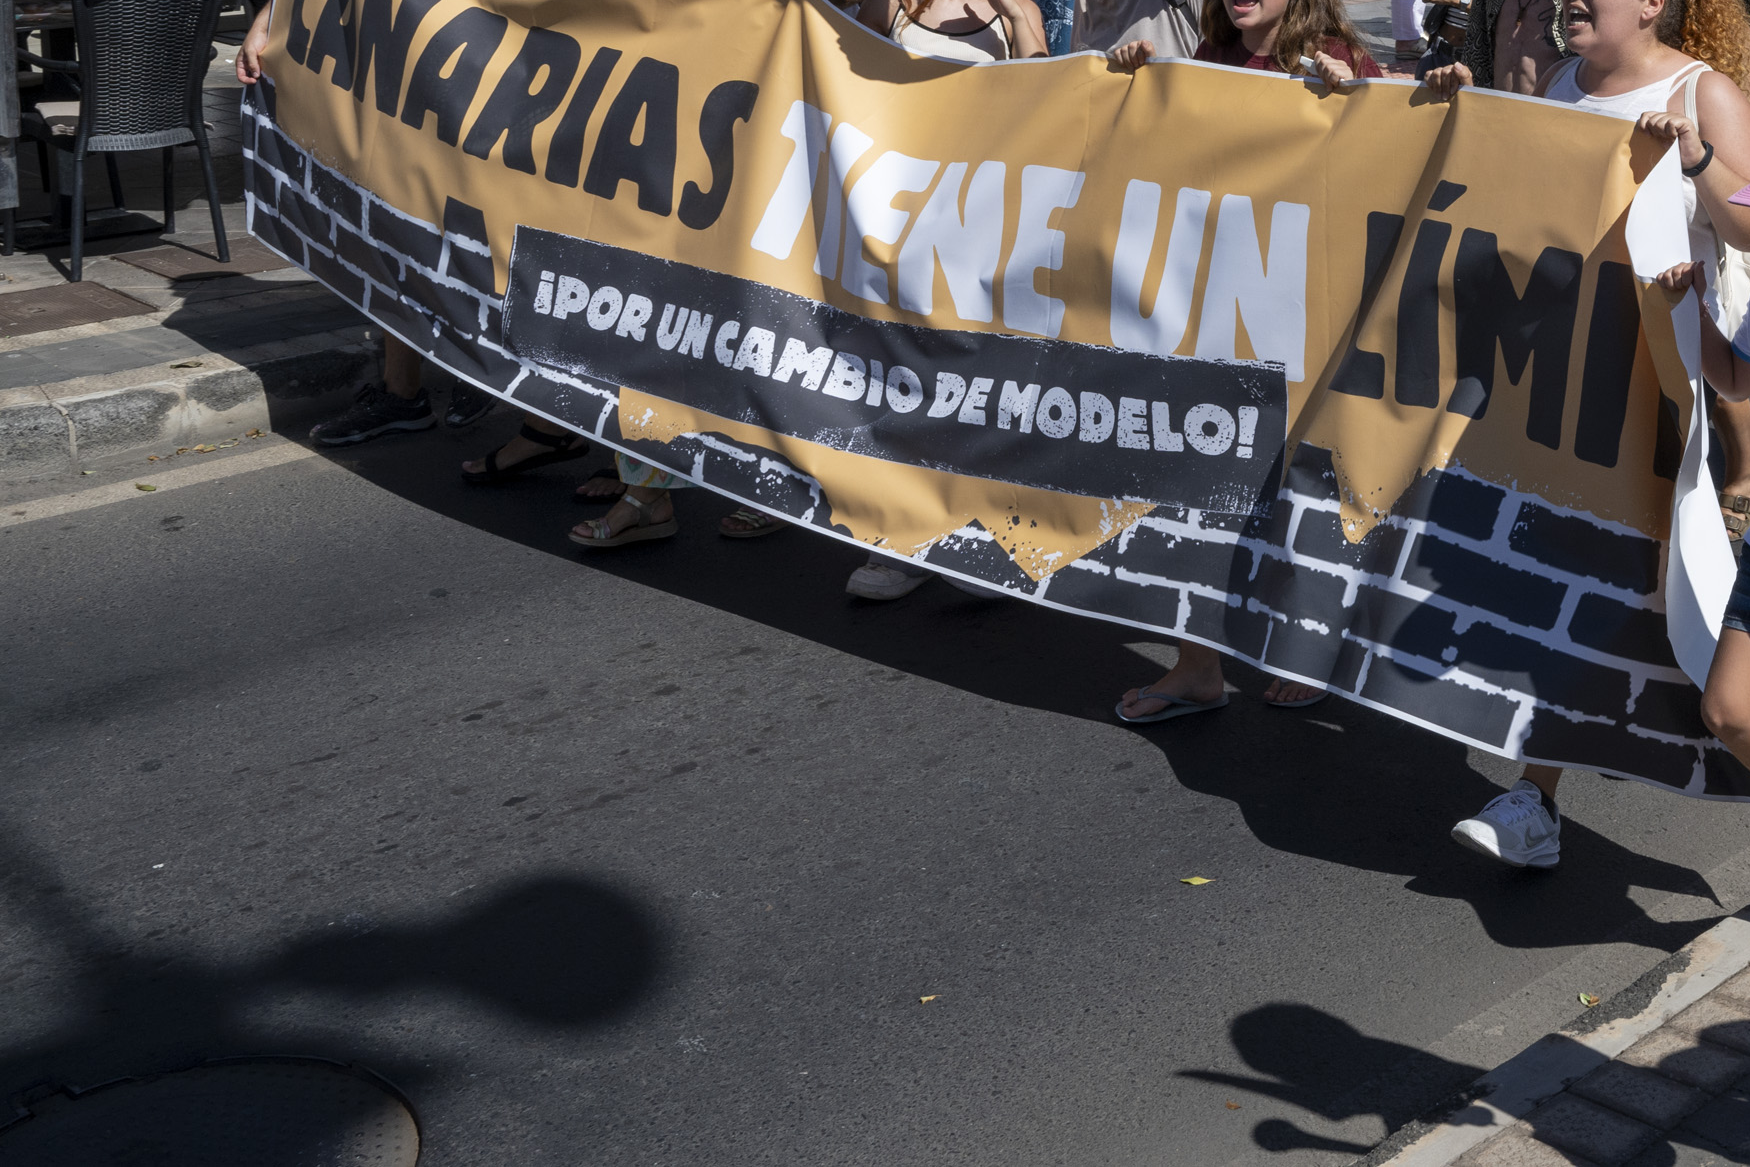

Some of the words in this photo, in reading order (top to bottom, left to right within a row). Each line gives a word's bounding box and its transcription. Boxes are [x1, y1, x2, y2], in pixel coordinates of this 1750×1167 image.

[750, 100, 1085, 339] TIENE
[1111, 177, 1310, 383] UN
[533, 270, 654, 339] ¡POR
[656, 301, 714, 359] UN
[714, 316, 930, 414] CAMBIO
[934, 371, 992, 426] DE
[996, 380, 1259, 460] MODELO!
